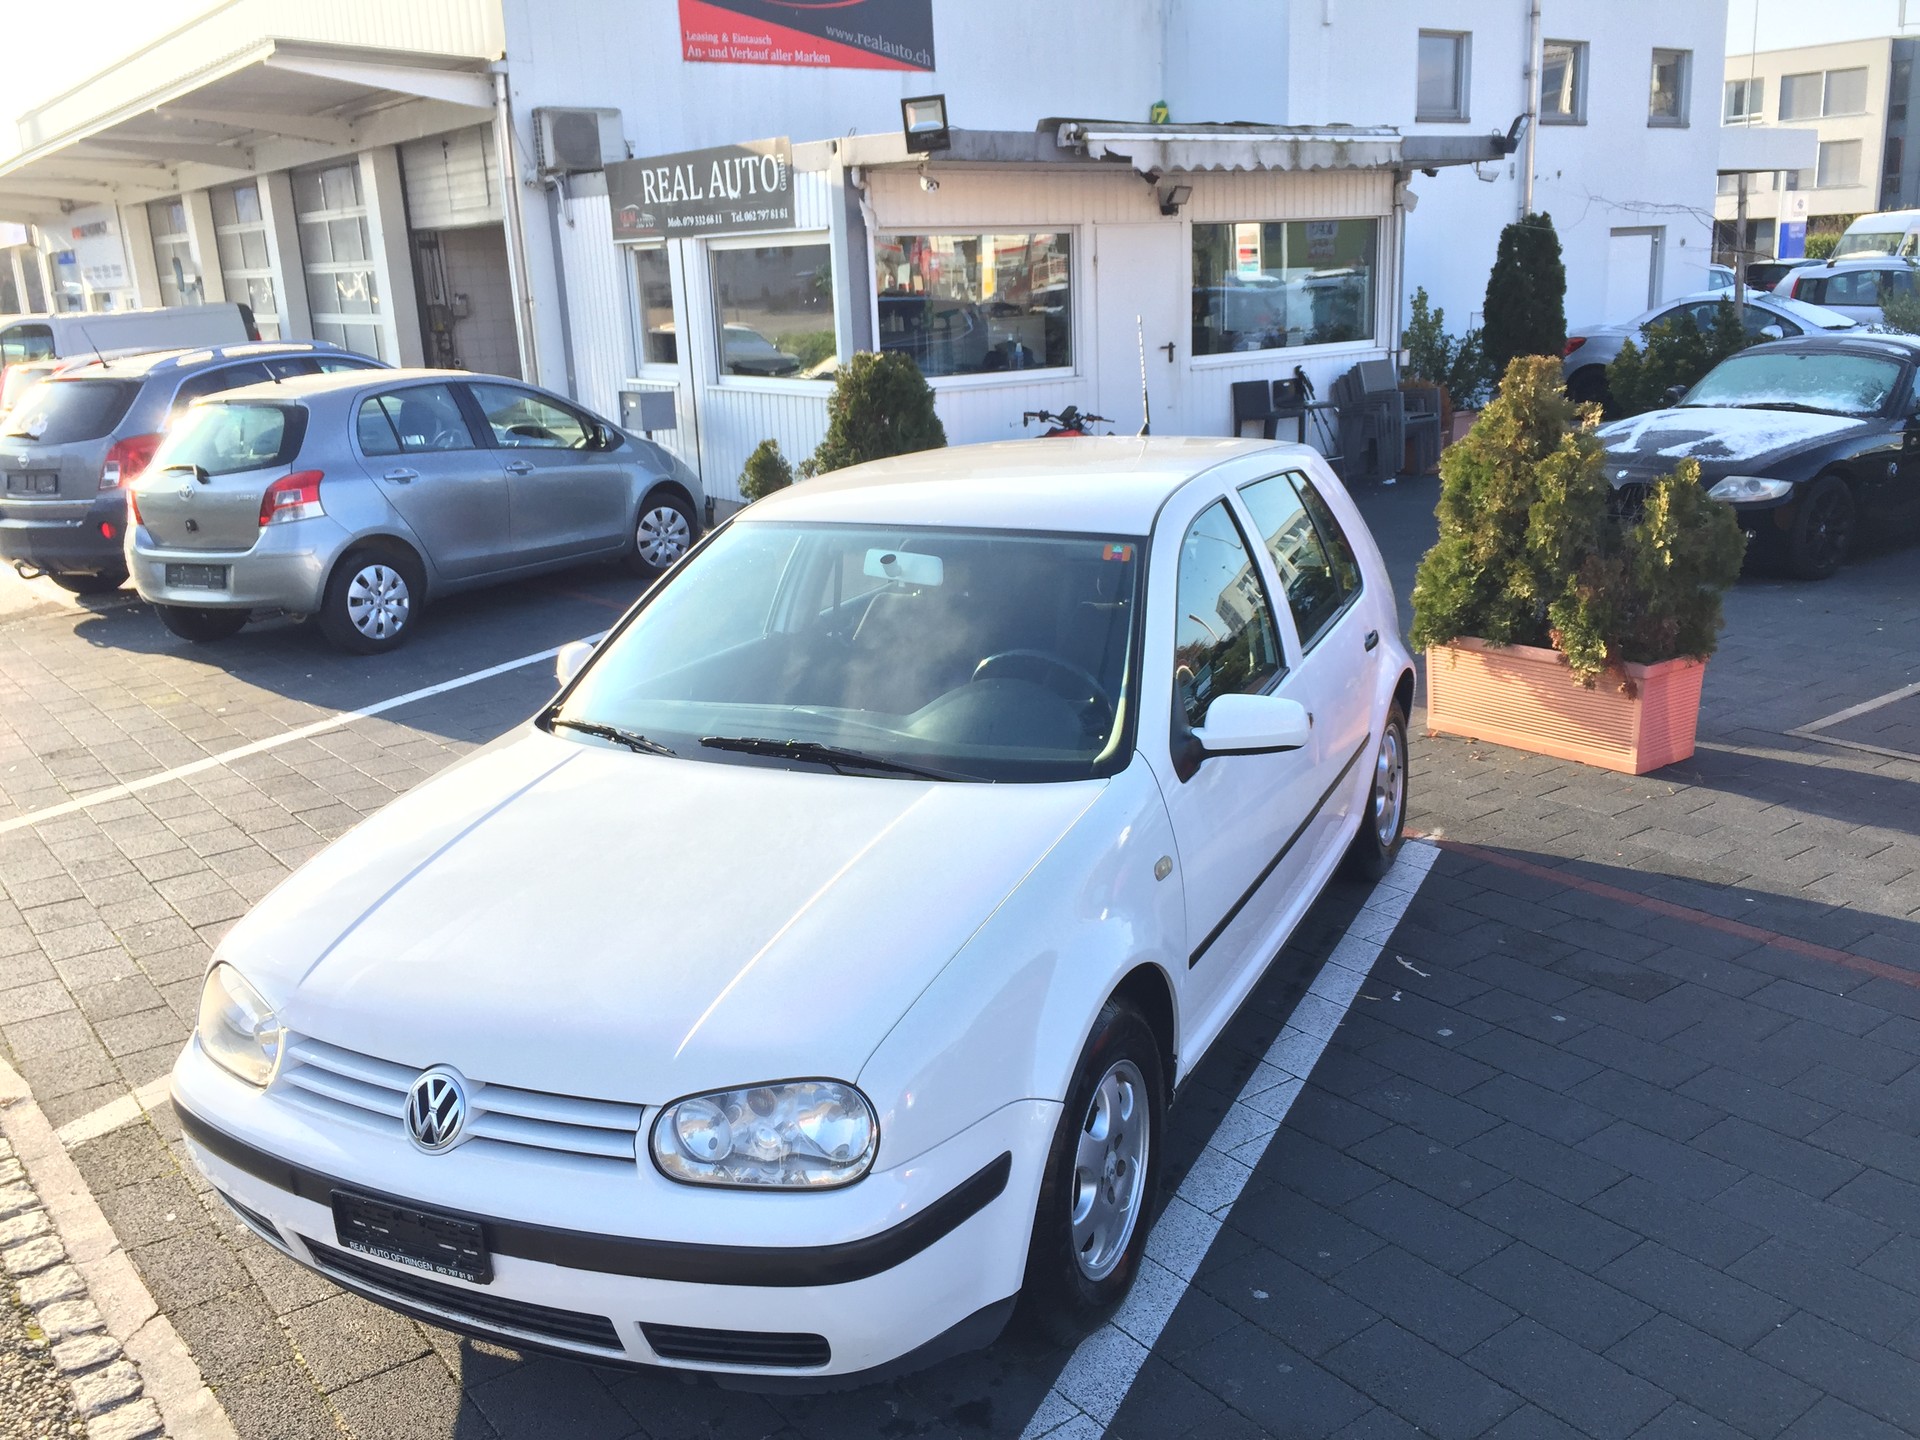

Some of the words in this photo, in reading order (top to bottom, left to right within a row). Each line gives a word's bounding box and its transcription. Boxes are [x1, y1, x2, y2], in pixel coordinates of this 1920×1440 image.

[686, 31, 718, 44] Leasing
[722, 33, 729, 43] &
[732, 33, 772, 45] Eintausch
[825, 25, 931, 67] www.realauto.ch
[687, 45, 706, 58] An-
[708, 46, 728, 59] und
[730, 47, 769, 60] Verkauf
[770, 49, 792, 62] aller
[794, 50, 831, 64] Marken
[641, 164, 703, 205] REAL
[708, 153, 779, 200] AUTO
[776, 153, 788, 192] GmbH
[715, 213, 722, 225] 11
[770, 208, 779, 220] 81
[780, 207, 788, 219] 81
[349, 1241, 369, 1254] REAL
[369, 1247, 390, 1259] AUTO
[390, 1253, 434, 1271] OFTRINGEN
[467, 1273, 474, 1281] 81
